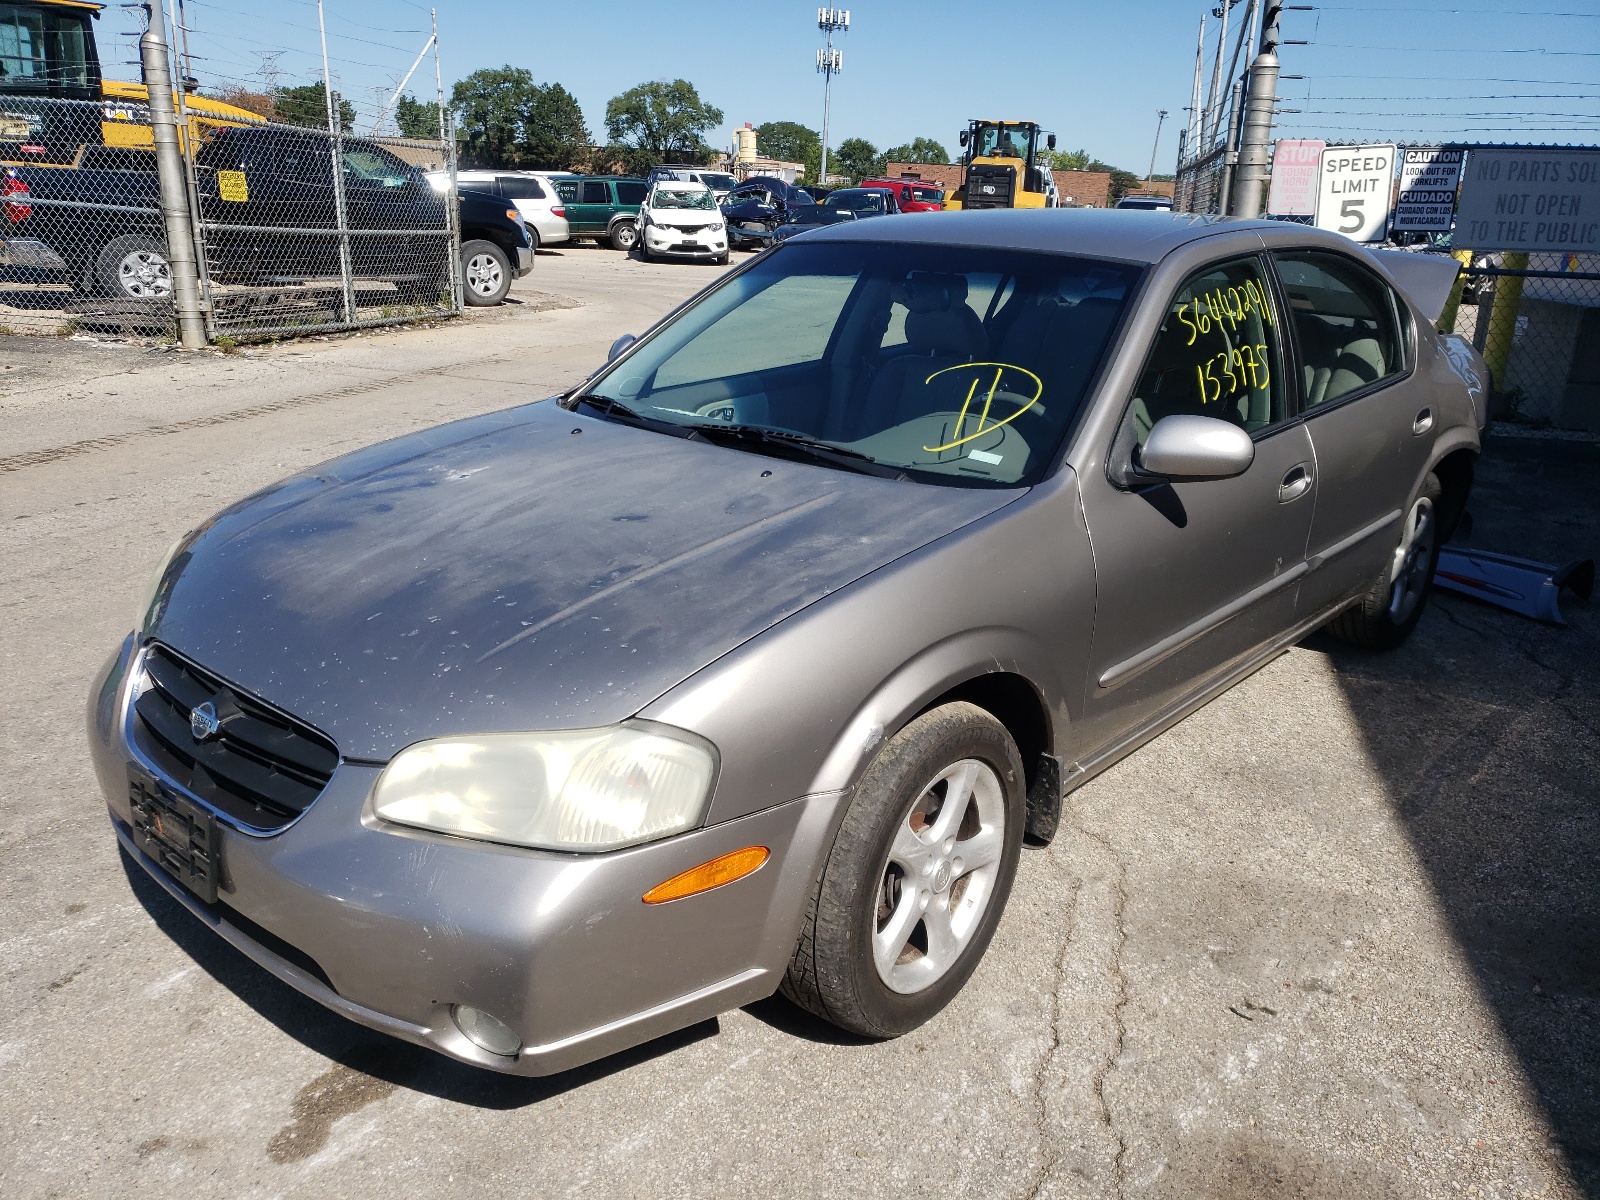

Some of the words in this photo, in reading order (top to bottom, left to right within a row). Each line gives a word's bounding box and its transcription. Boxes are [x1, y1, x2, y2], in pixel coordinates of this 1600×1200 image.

[1280, 146, 1319, 163] STOP
[1406, 151, 1461, 163] CAUTION
[1280, 167, 1313, 177] SOUND
[1326, 157, 1387, 173] SPEED
[1405, 167, 1425, 176] LOOK
[1426, 167, 1441, 176] OUT
[1442, 167, 1457, 176] FOR
[1477, 159, 1500, 181] NO
[1507, 160, 1562, 183] PARTS
[1282, 177, 1308, 186] HORN
[1331, 178, 1380, 194] LIMIT
[1410, 178, 1449, 186] FORKLIFTS
[1400, 191, 1453, 203] CUIDADO
[1494, 193, 1530, 215] NOT
[1535, 194, 1582, 216] OPEN
[1337, 199, 1366, 234] 5
[1398, 206, 1425, 215] CUIDADO
[1425, 206, 1439, 215] CON
[1440, 206, 1452, 215] LOS
[1400, 216, 1446, 225] MONTACARGAS
[1469, 220, 1489, 241] TO
[1497, 220, 1530, 242] THE
[1534, 221, 1599, 244] PUBLIC
[1178, 277, 1273, 347] 56442291
[1197, 344, 1271, 404] 153975
